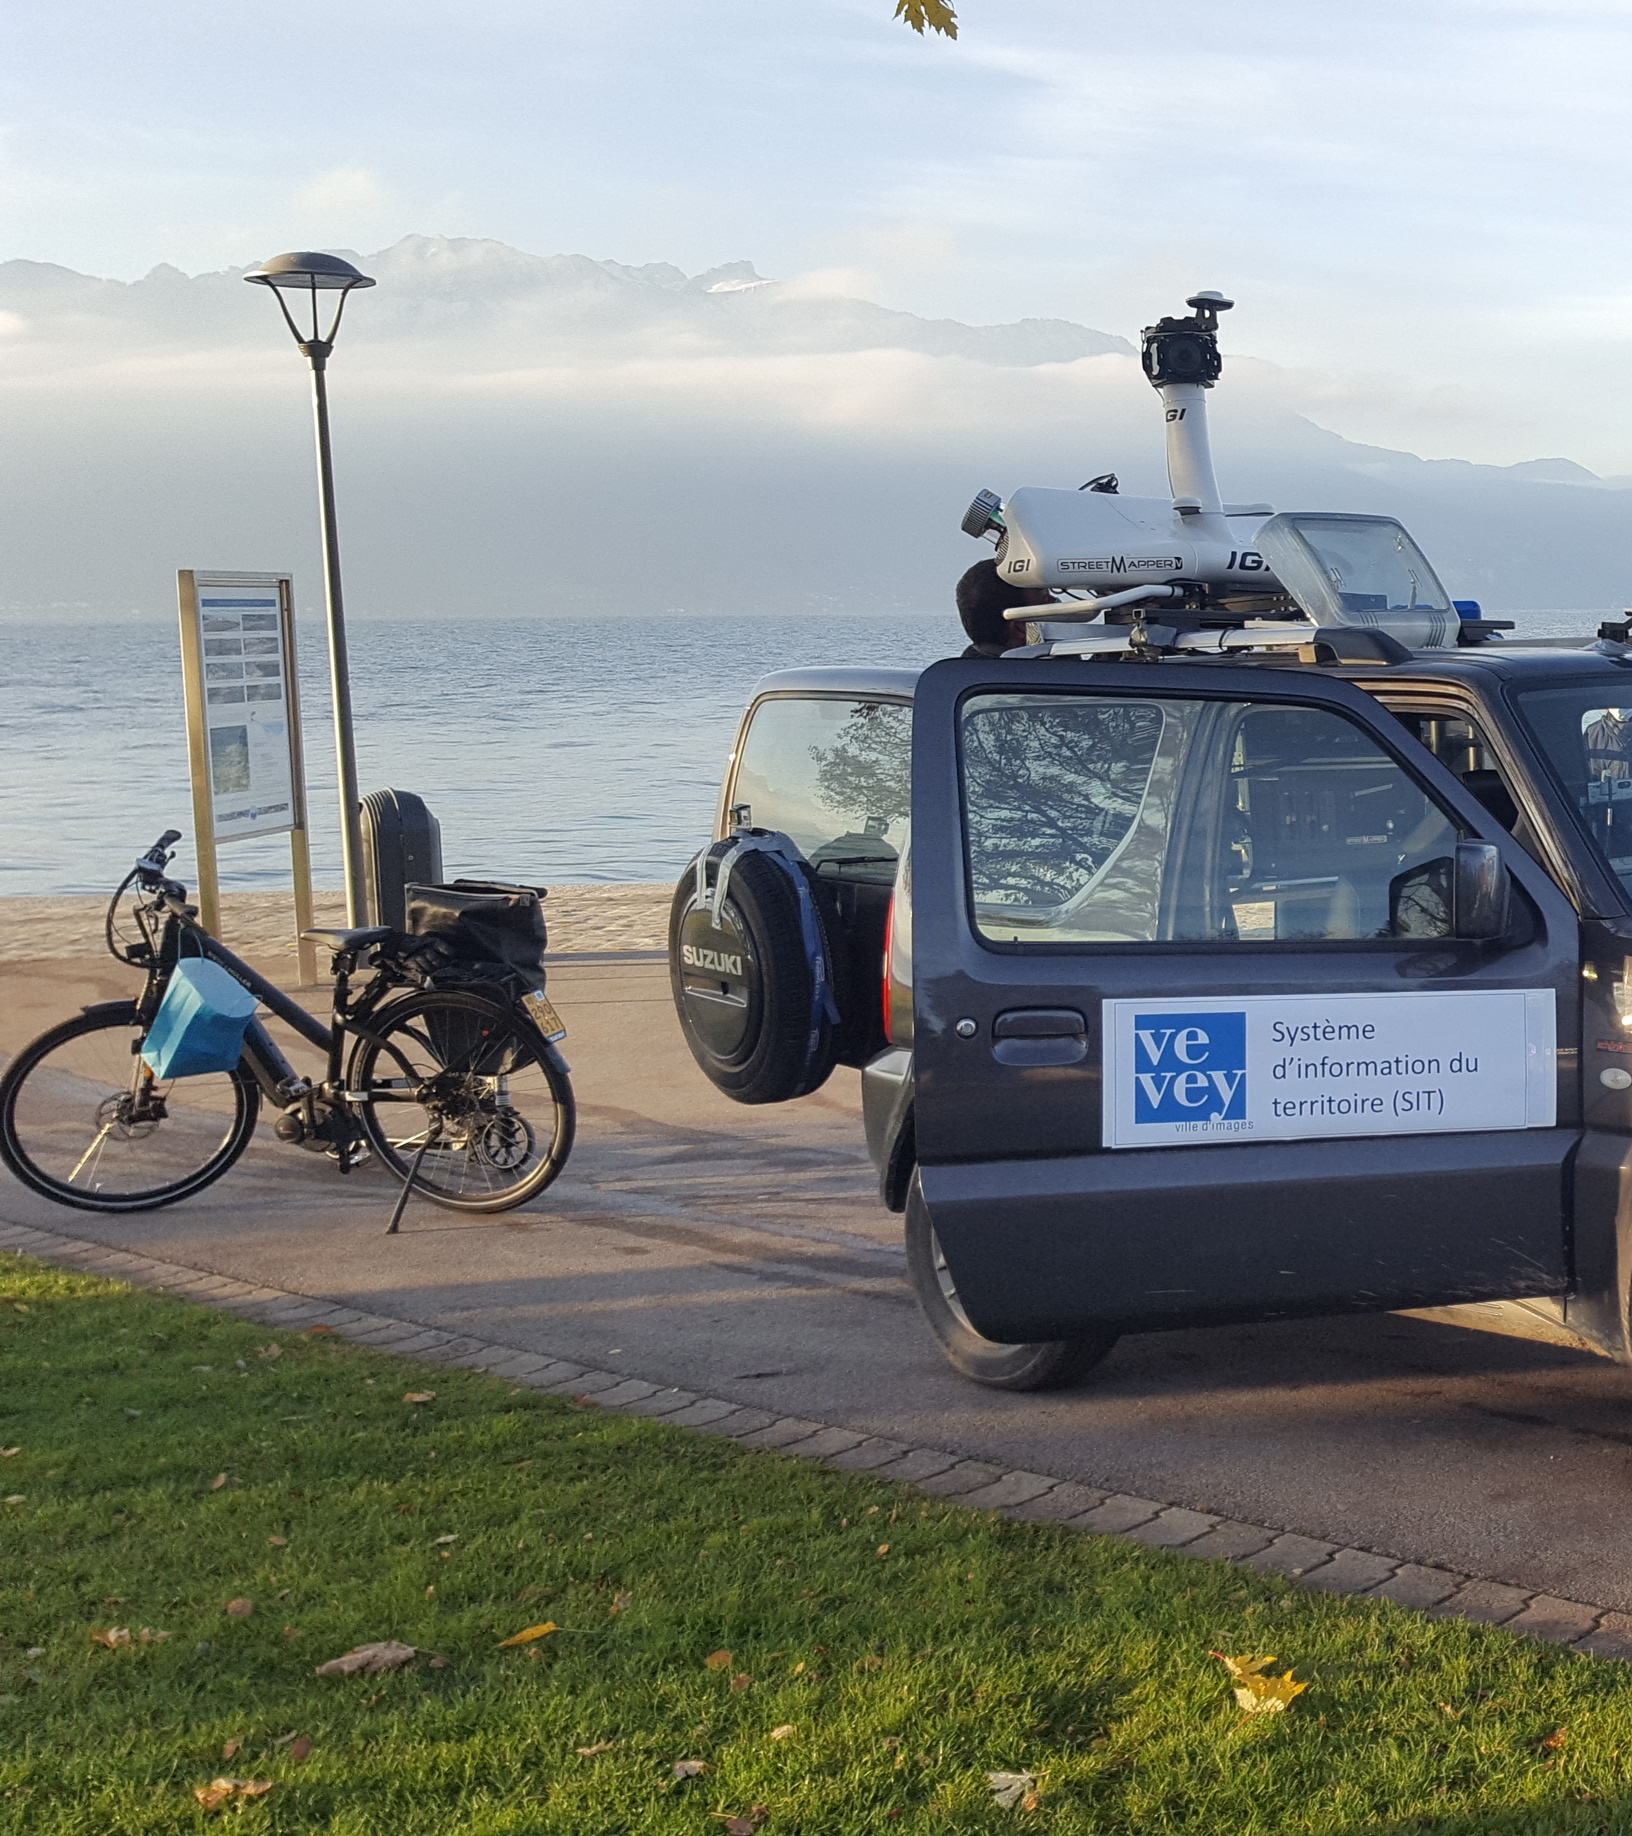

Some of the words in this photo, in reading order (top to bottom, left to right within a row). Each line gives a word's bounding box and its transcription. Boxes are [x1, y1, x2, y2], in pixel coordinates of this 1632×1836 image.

[1166, 408, 1187, 422] GI
[1008, 559, 1031, 573] IGI
[683, 945, 742, 976] SUZUKI
[531, 1003, 551, 1020] 290
[1272, 1018, 1376, 1047] Système
[1135, 1027, 1210, 1066] ve
[1449, 1052, 1479, 1074] du
[1135, 1070, 1247, 1121] vey
[1272, 1093, 1384, 1118] territoire
[1393, 1088, 1445, 1117] (SIT)
[1175, 1121, 1199, 1132] ville
